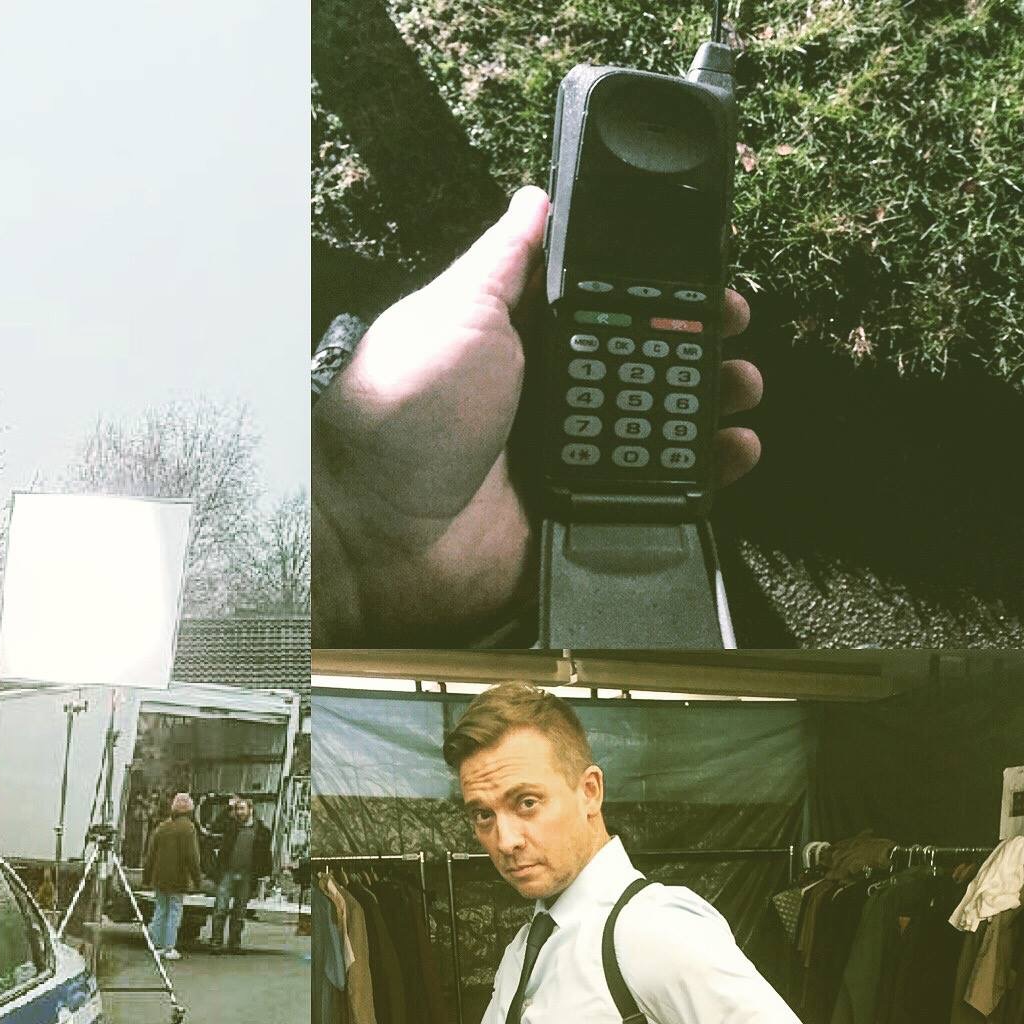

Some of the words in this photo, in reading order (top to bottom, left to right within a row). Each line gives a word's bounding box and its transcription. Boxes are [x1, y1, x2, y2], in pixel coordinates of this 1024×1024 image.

[615, 342, 629, 350] OK
[581, 362, 592, 376] 1
[630, 367, 645, 379] 2
[678, 370, 691, 382] 3
[577, 392, 592, 404] 4
[628, 395, 642, 407] 5
[677, 397, 690, 410] 6
[576, 420, 590, 432] 7
[626, 422, 640, 434] 8
[674, 424, 687, 437] 9
